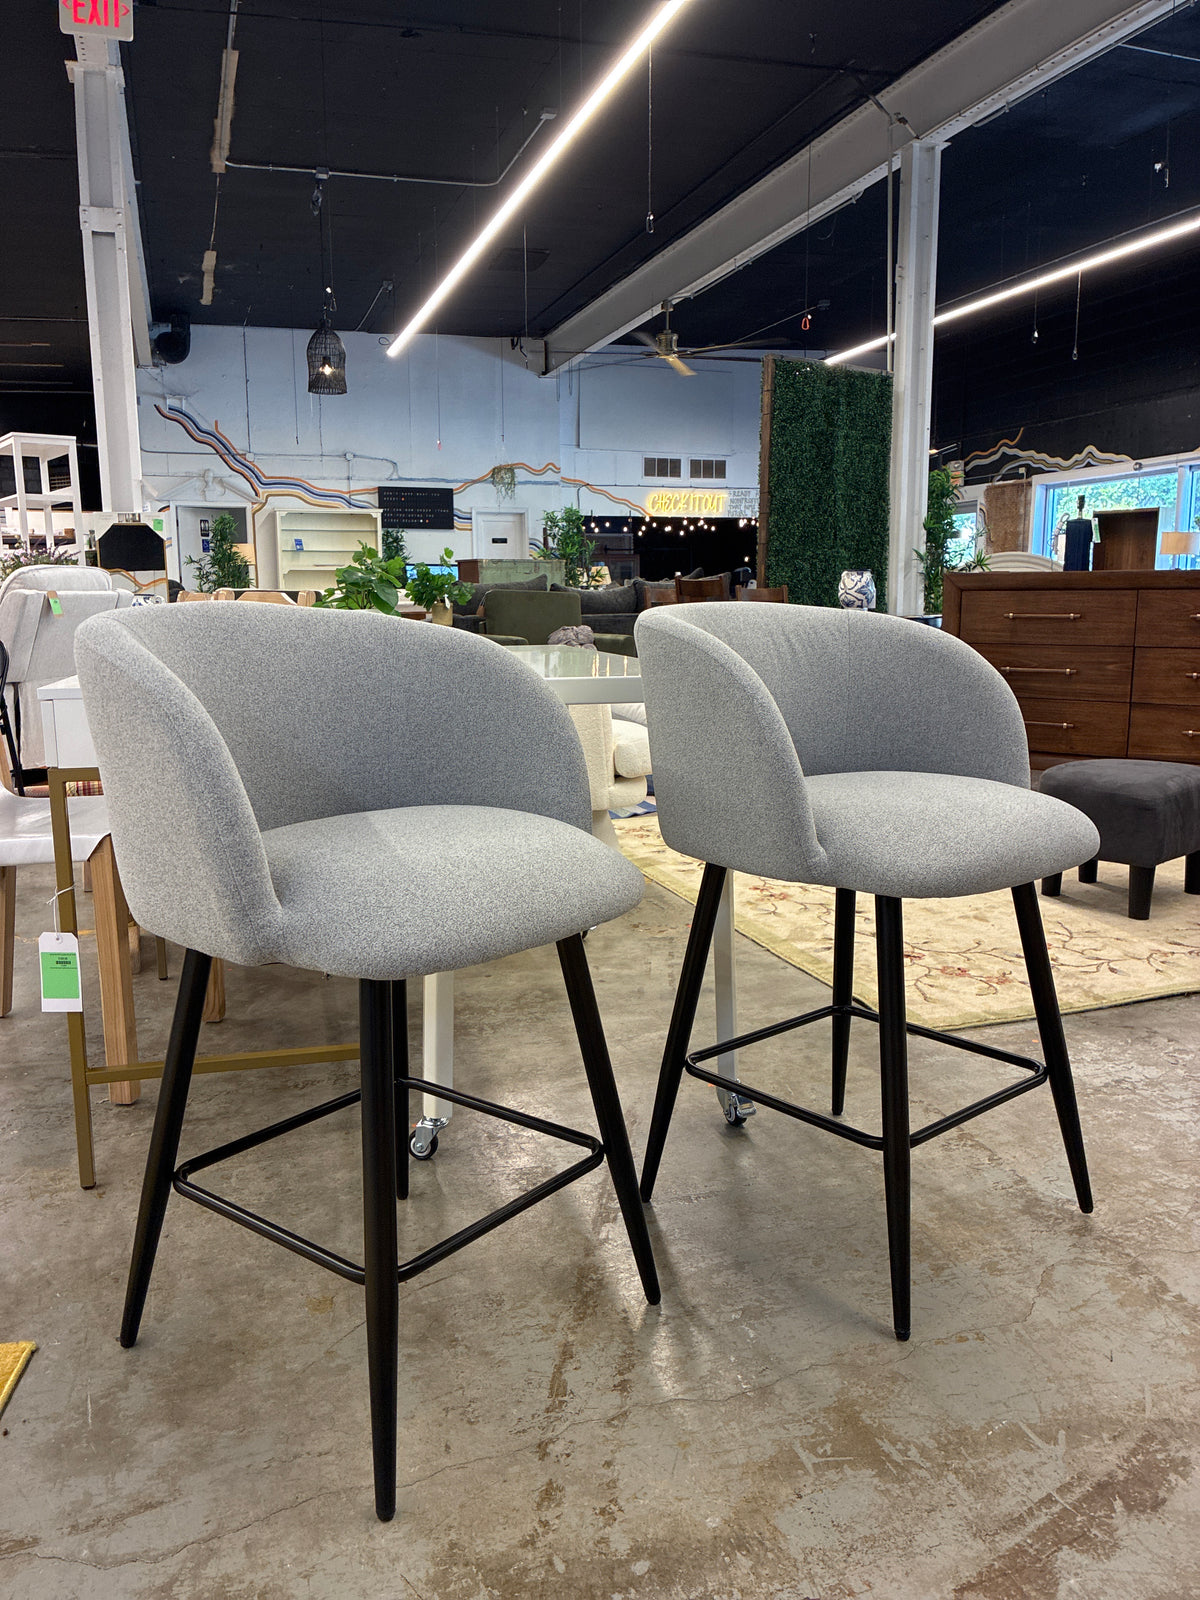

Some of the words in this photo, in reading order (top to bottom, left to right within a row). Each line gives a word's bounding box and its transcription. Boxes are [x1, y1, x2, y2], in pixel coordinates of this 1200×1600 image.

[649, 493, 688, 513] CHECK
[689, 494, 704, 513] IT
[703, 493, 728, 513] OUT
